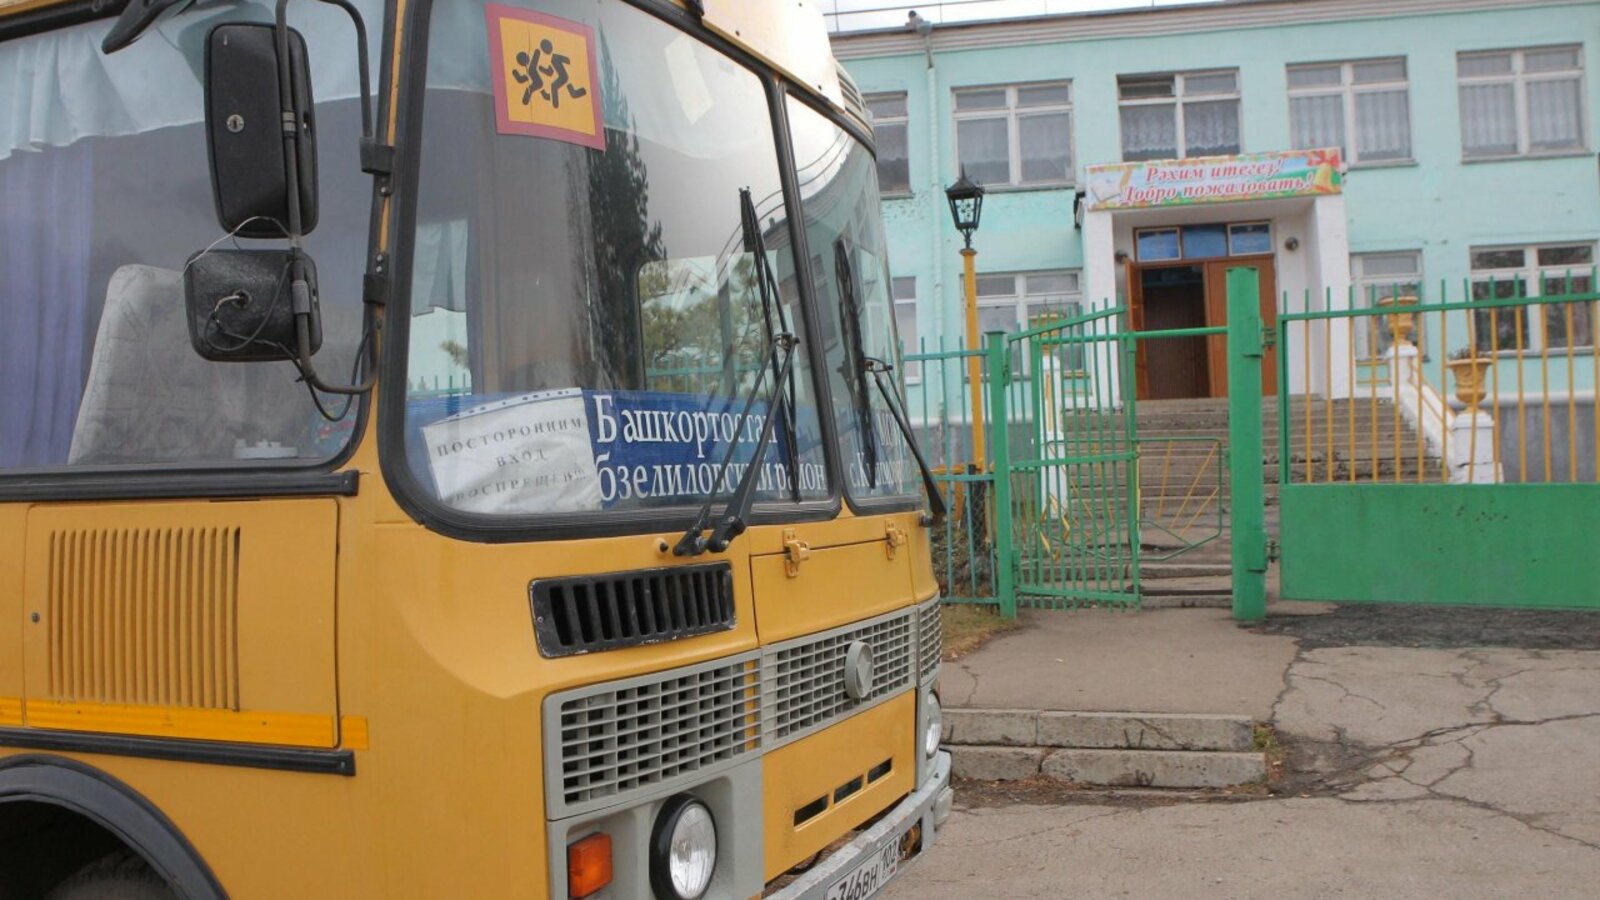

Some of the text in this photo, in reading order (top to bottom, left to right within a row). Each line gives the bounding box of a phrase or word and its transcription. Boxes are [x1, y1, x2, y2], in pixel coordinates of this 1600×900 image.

[1210, 158, 1284, 178] итегез!
[1120, 173, 1315, 205] Добро пожаловать!
[436, 417, 581, 457] ПОСТОРОННИМ
[496, 448, 549, 468] ВХОД
[831, 839, 898, 900] 346ВН 102
